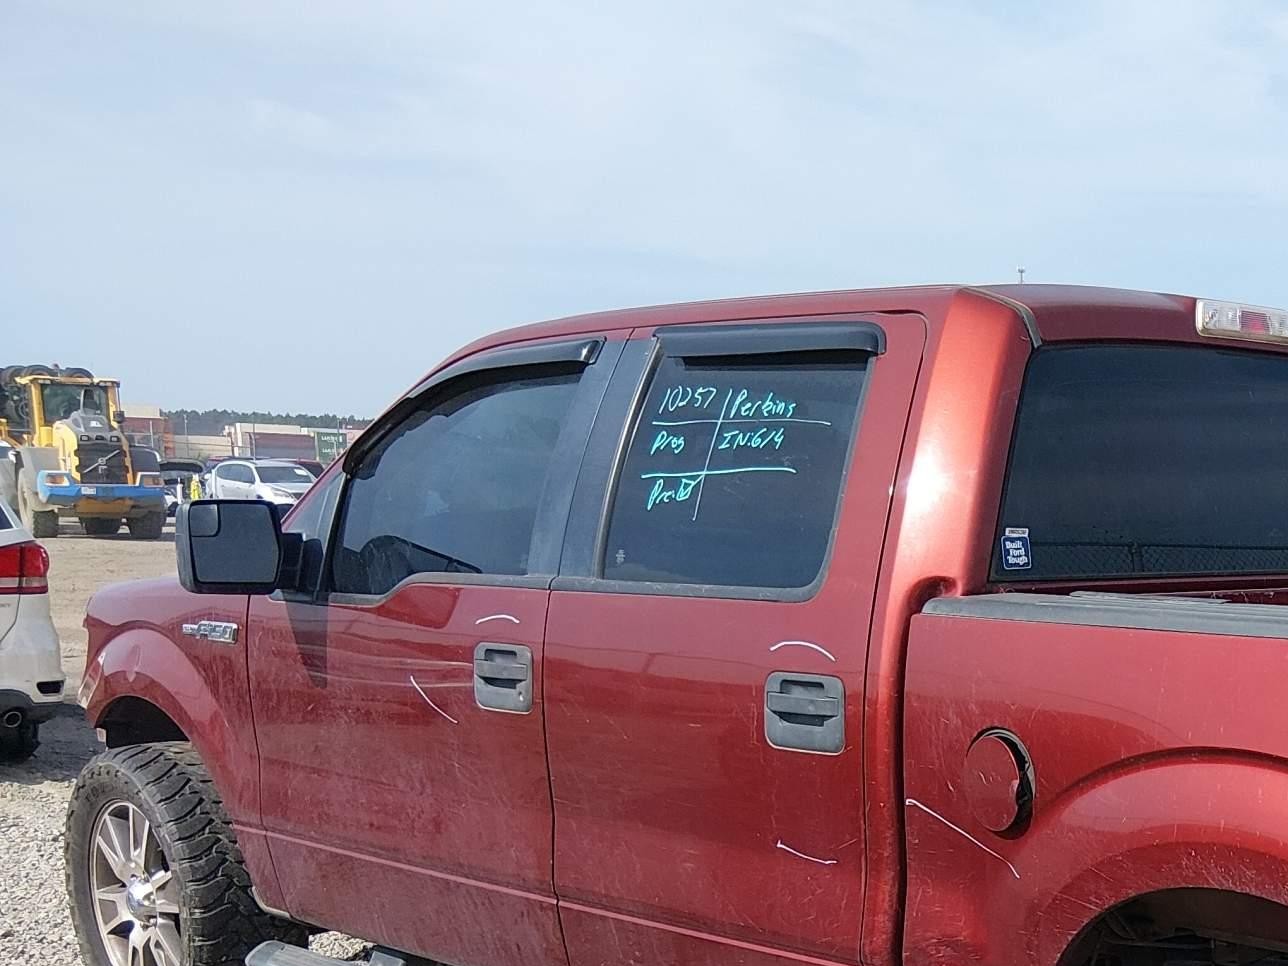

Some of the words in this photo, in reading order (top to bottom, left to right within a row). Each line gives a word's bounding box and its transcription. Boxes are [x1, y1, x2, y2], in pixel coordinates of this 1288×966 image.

[659, 385, 717, 414] 10257
[729, 388, 797, 418] Perkins
[1005, 540, 1023, 549] Built
[1009, 548, 1026, 556] Ford
[1006, 556, 1028, 566] Tough
